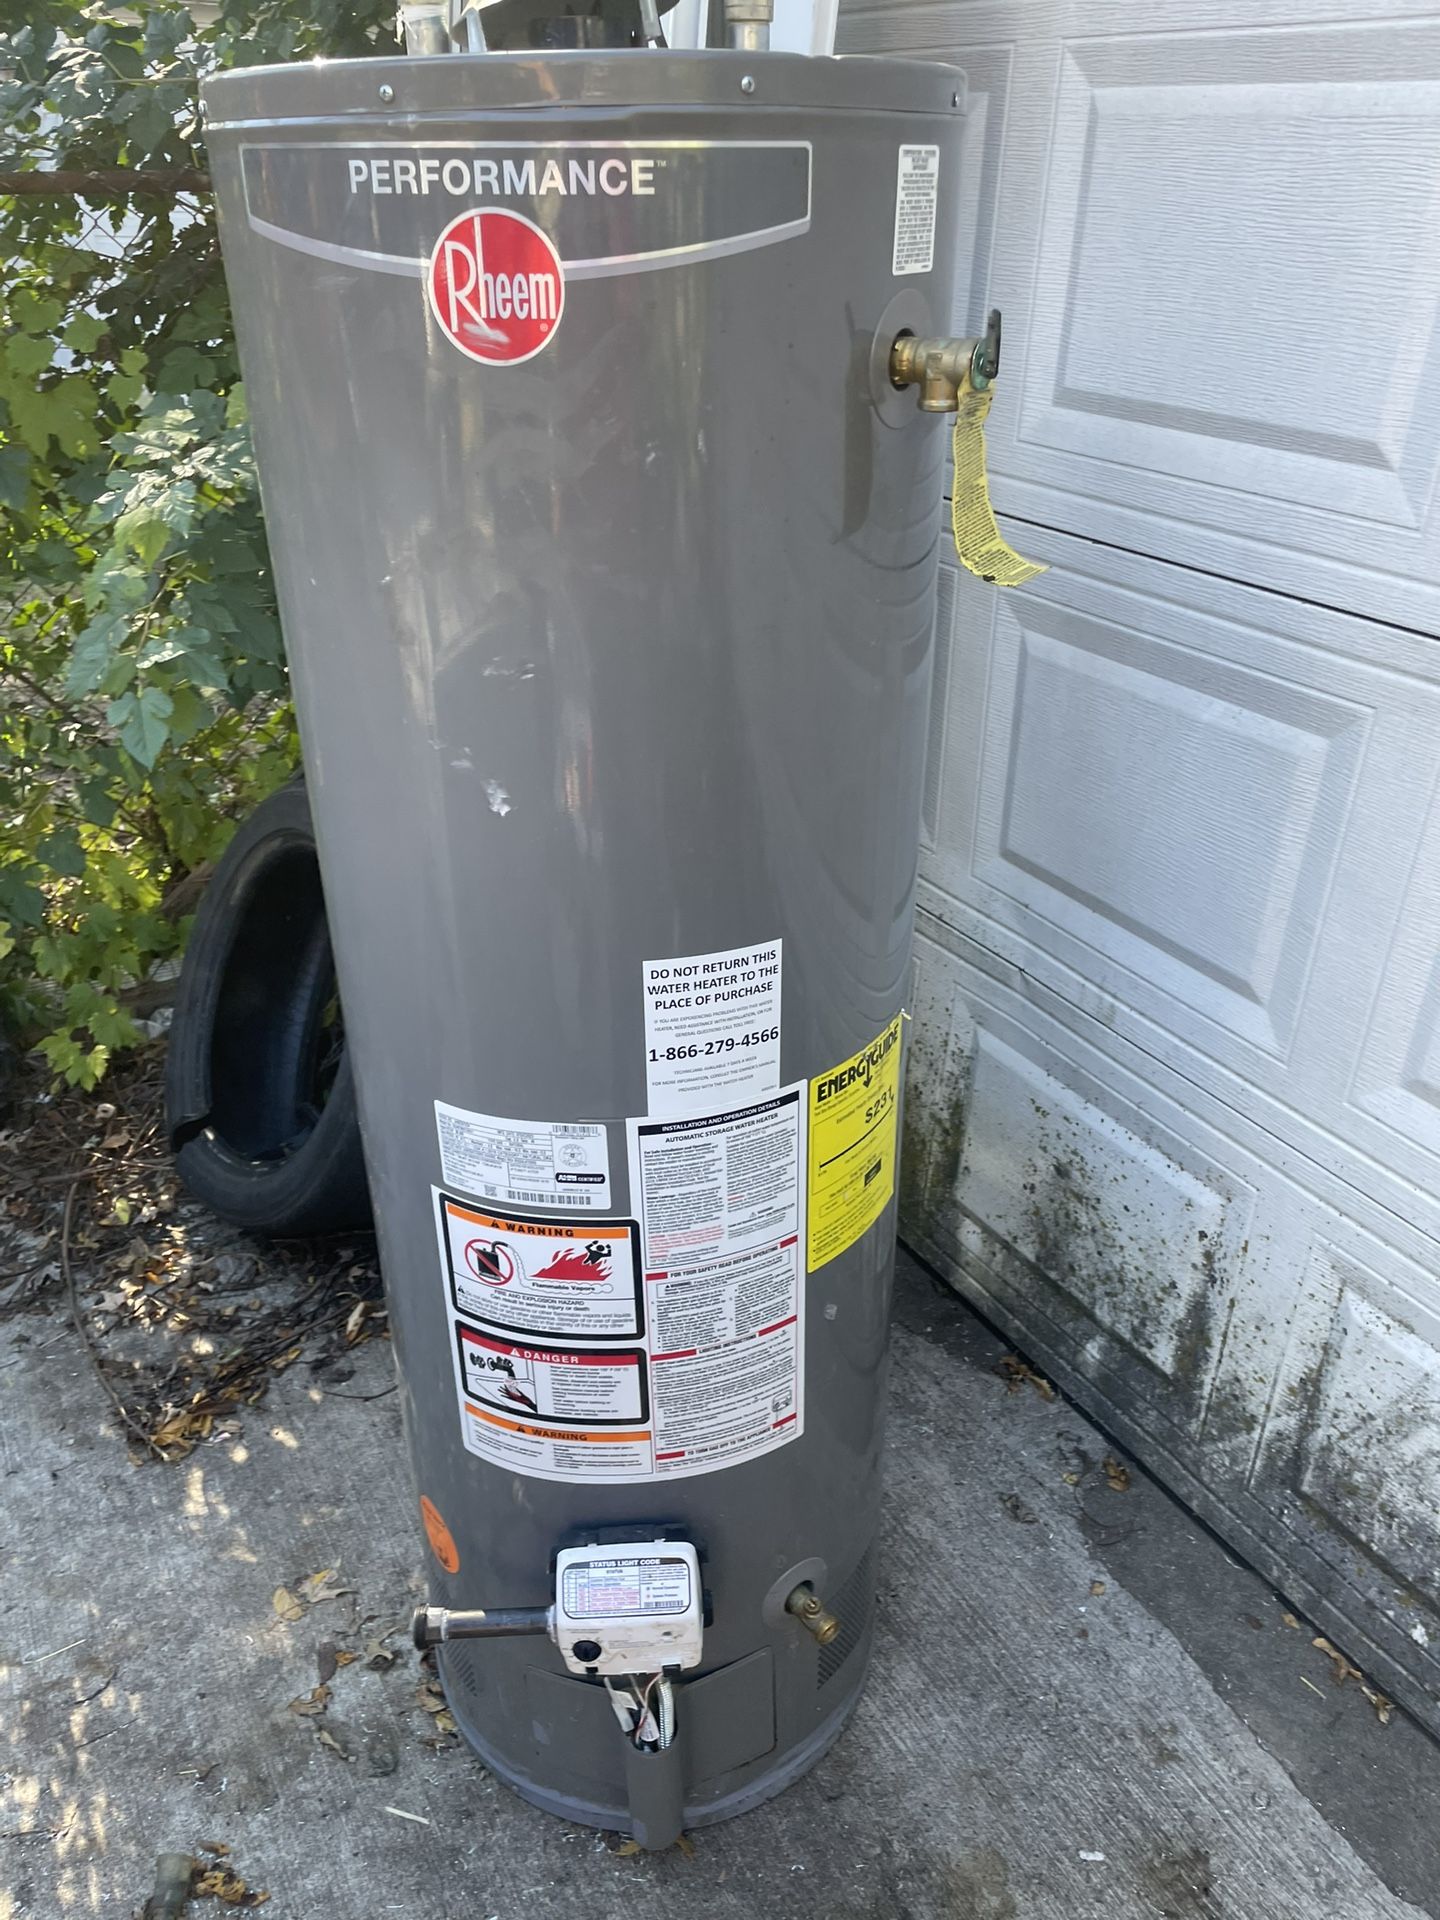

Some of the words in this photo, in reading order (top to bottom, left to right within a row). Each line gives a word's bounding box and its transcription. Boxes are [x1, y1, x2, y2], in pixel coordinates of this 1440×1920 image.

[444, 215, 557, 333] Rheem
[650, 969, 670, 980] DO
[673, 965, 699, 978] NOT
[702, 957, 749, 974] RETURN
[752, 949, 776, 964] THIS
[647, 982, 690, 996] WATER
[693, 974, 737, 991] HEATER
[740, 970, 755, 982] TO
[758, 964, 779, 978] THE
[655, 997, 692, 1010] PLACE
[695, 994, 711, 1006] OF
[714, 981, 773, 1003] PURCHASE
[649, 1026, 779, 1062] 1-866-279-4566
[662, 1119, 707, 1132] INSTALLATION
[708, 1116, 722, 1125] AND
[723, 1107, 757, 1122] OPERATION
[758, 1100, 781, 1112] DETAILS
[665, 1132, 704, 1143] AUTOMATIC
[705, 1126, 734, 1137] STORAGE
[735, 1120, 755, 1130] WATER
[756, 1112, 778, 1124] HEATER
[505, 1223, 575, 1237] WARNING
[683, 1269, 697, 1277] YOUR
[698, 1264, 717, 1274] SAFETY
[532, 1281, 569, 1291] Flammable
[521, 1295, 556, 1304] EXPLOSION
[524, 1350, 579, 1364] DANGER
[532, 1428, 588, 1441] WARNING
[589, 1560, 617, 1568] STATUS
[617, 1559, 639, 1567] LIGHT
[640, 1558, 660, 1566] CODE
